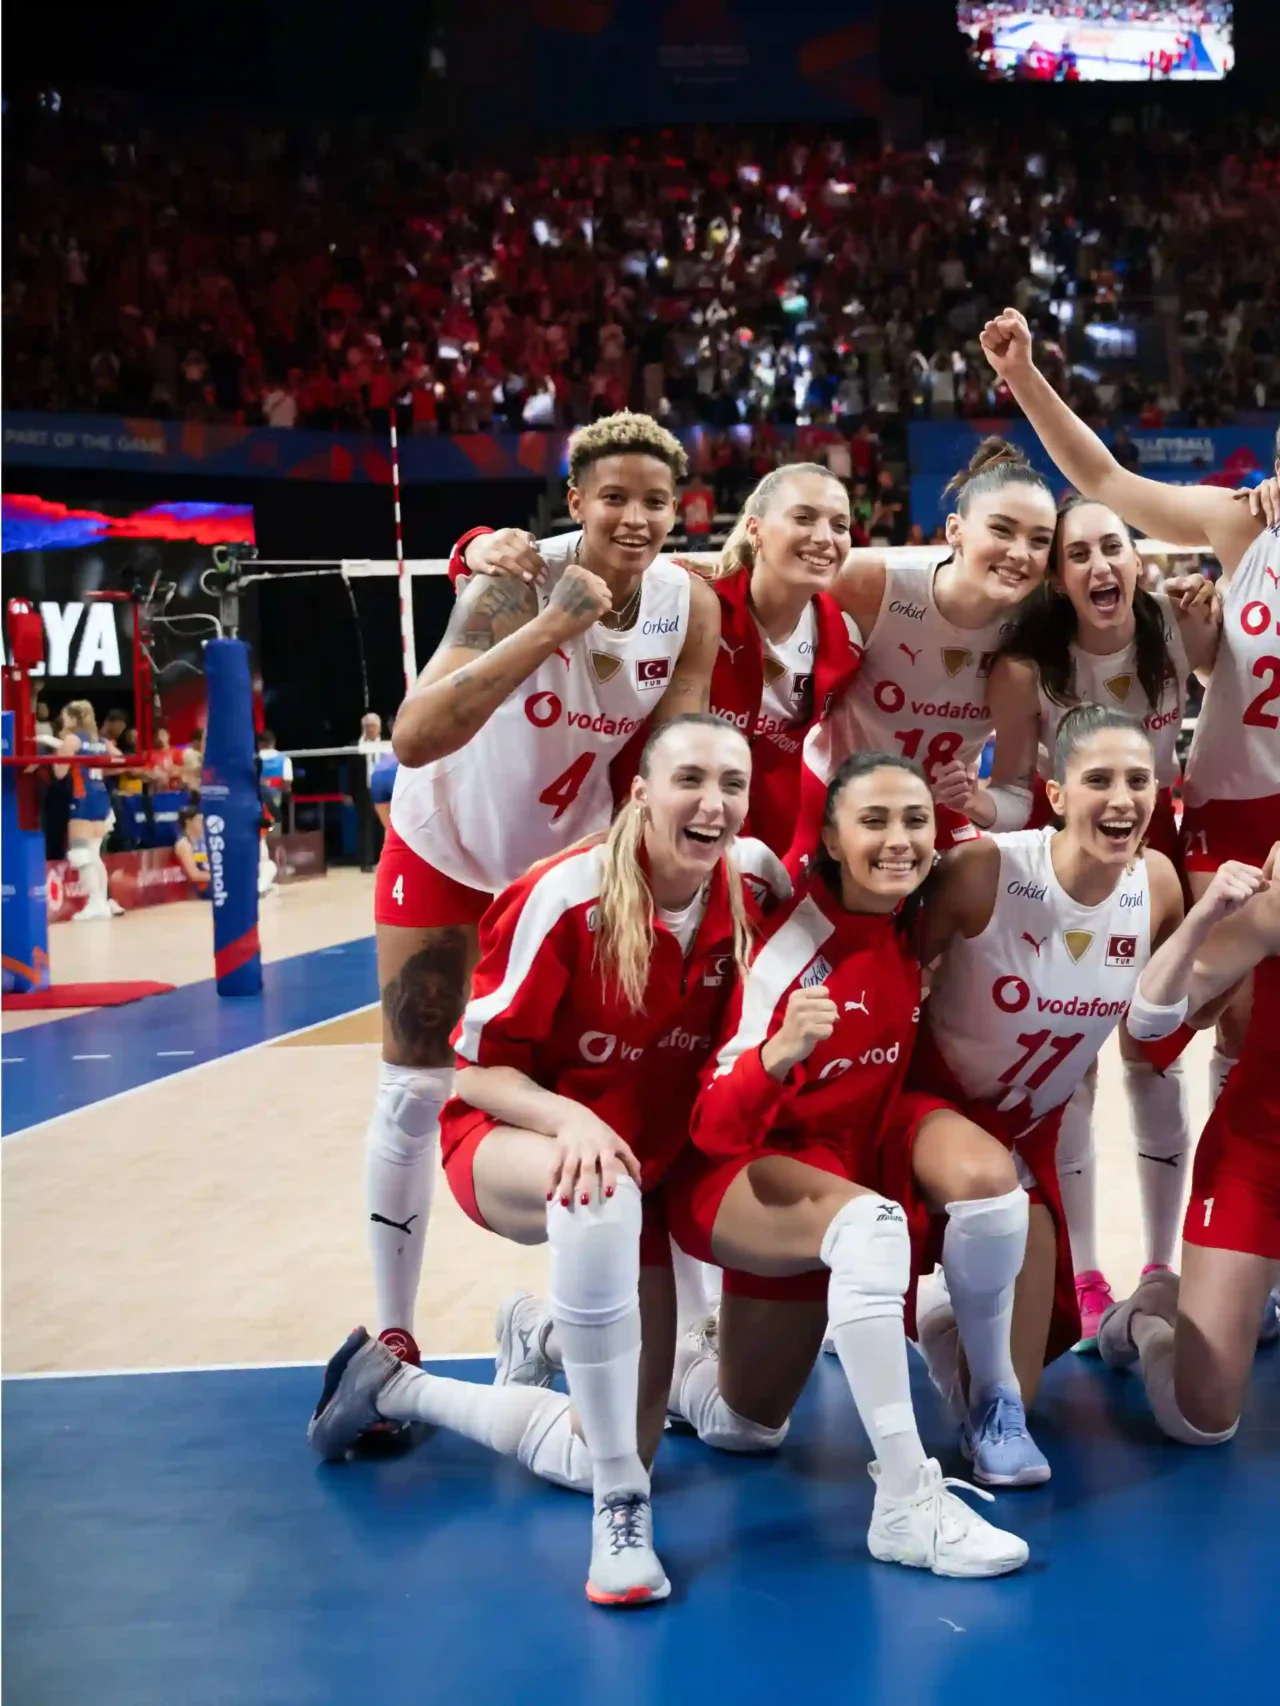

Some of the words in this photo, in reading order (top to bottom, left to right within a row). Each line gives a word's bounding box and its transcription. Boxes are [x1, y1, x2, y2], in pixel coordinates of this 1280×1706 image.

[889, 600, 927, 621] Orkid
[642, 615, 680, 635] Orkid
[644, 680, 661, 688] TUR
[911, 701, 991, 720] vodafon
[893, 728, 963, 781] 18
[539, 752, 596, 820] 4
[392, 874, 404, 905] 4
[1007, 881, 1048, 902] Orkid
[998, 1029, 1085, 1090] 11
[1203, 1198, 1215, 1227] 1
